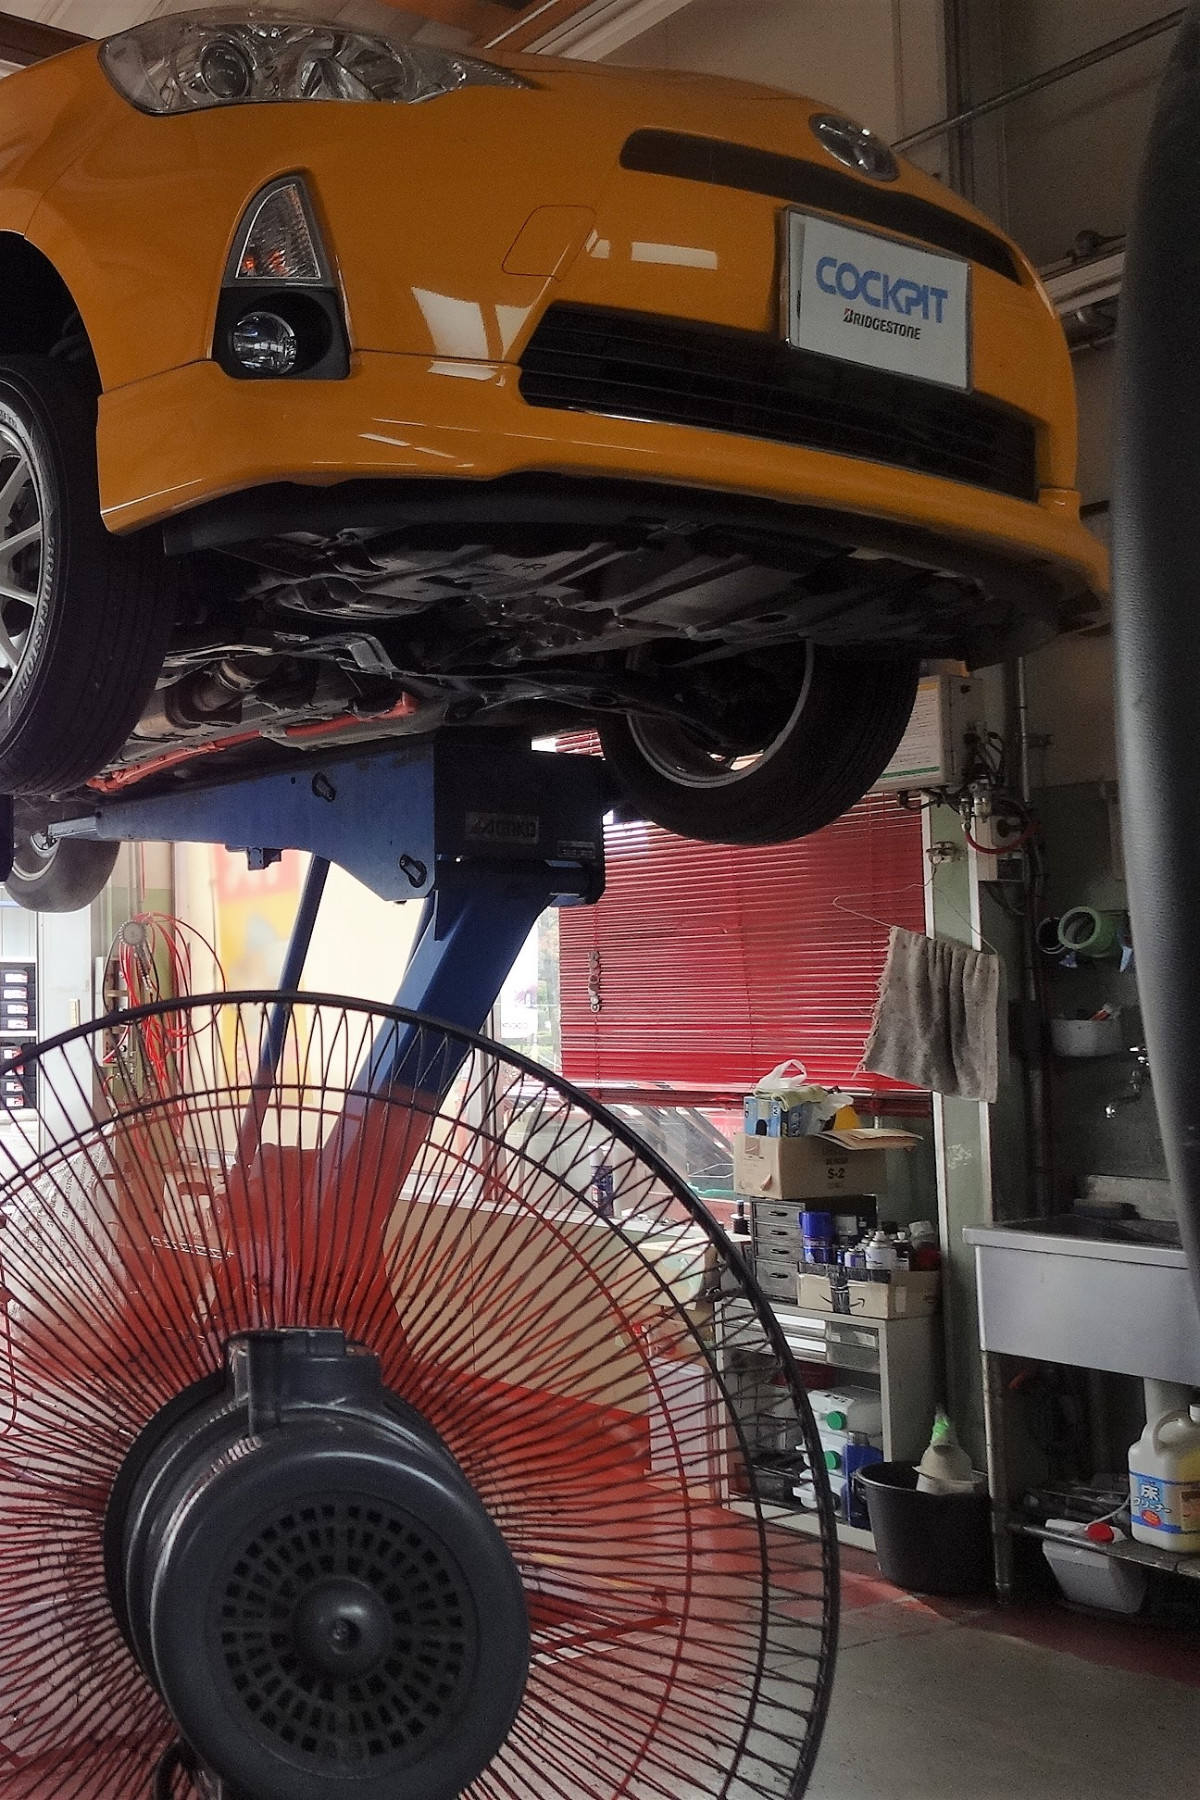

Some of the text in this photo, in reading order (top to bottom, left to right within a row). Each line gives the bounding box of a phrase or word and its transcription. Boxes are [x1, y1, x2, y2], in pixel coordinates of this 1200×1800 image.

[815, 255, 949, 324] COCKPIT
[843, 307, 922, 340] BRIDGESTONE
[1140, 1484, 1160, 1501] 床
